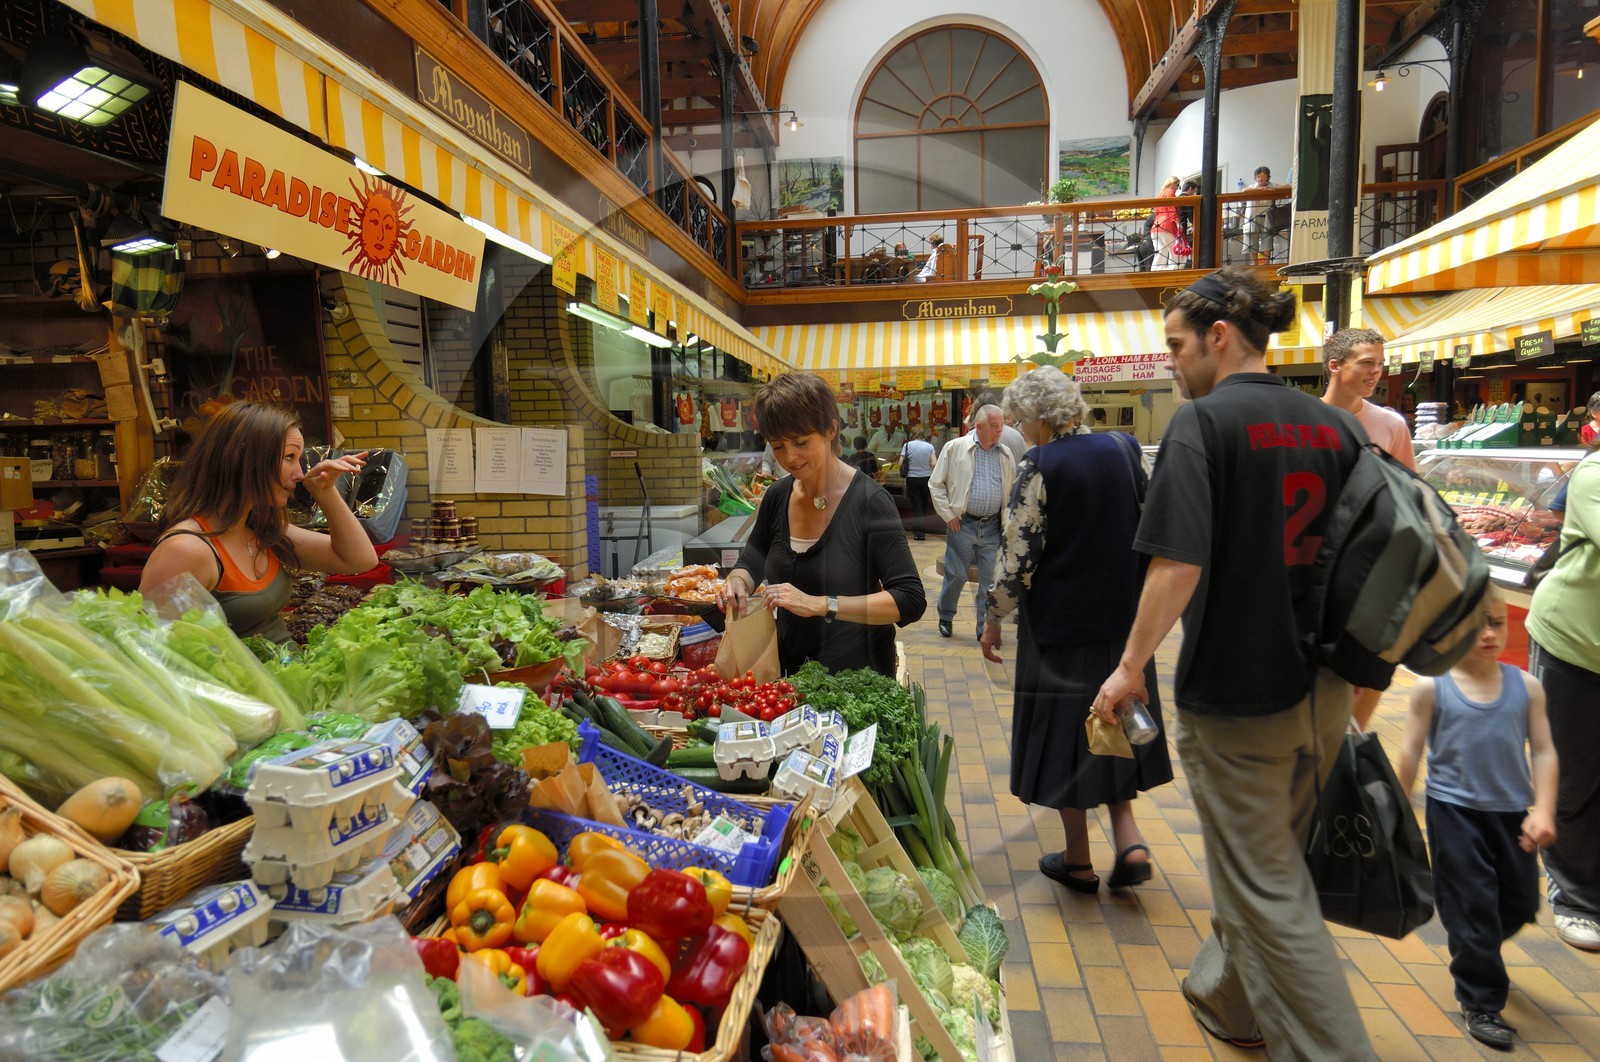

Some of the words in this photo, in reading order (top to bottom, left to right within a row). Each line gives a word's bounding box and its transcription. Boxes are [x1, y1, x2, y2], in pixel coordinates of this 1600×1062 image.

[429, 65, 522, 163] Moynihan
[189, 135, 353, 235] PARADISE
[406, 228, 476, 283] GARDEN
[916, 299, 997, 318] Moynihan
[1520, 337, 1544, 348] FRESH
[240, 345, 278, 371] THE
[1520, 346, 1543, 356] QUAIL
[1096, 357, 1119, 365] LOIN,
[1121, 355, 1141, 363] HAM
[1142, 354, 1150, 362] &
[1132, 363, 1156, 371] LOIN
[1075, 365, 1122, 375] SAUSAGES
[1132, 371, 1155, 379] HAM
[1075, 374, 1113, 383] PUDDING
[230, 375, 323, 403] GARDEN
[1282, 471, 1327, 566] 2
[205, 907, 216, 922] L
[239, 887, 250, 899] A
